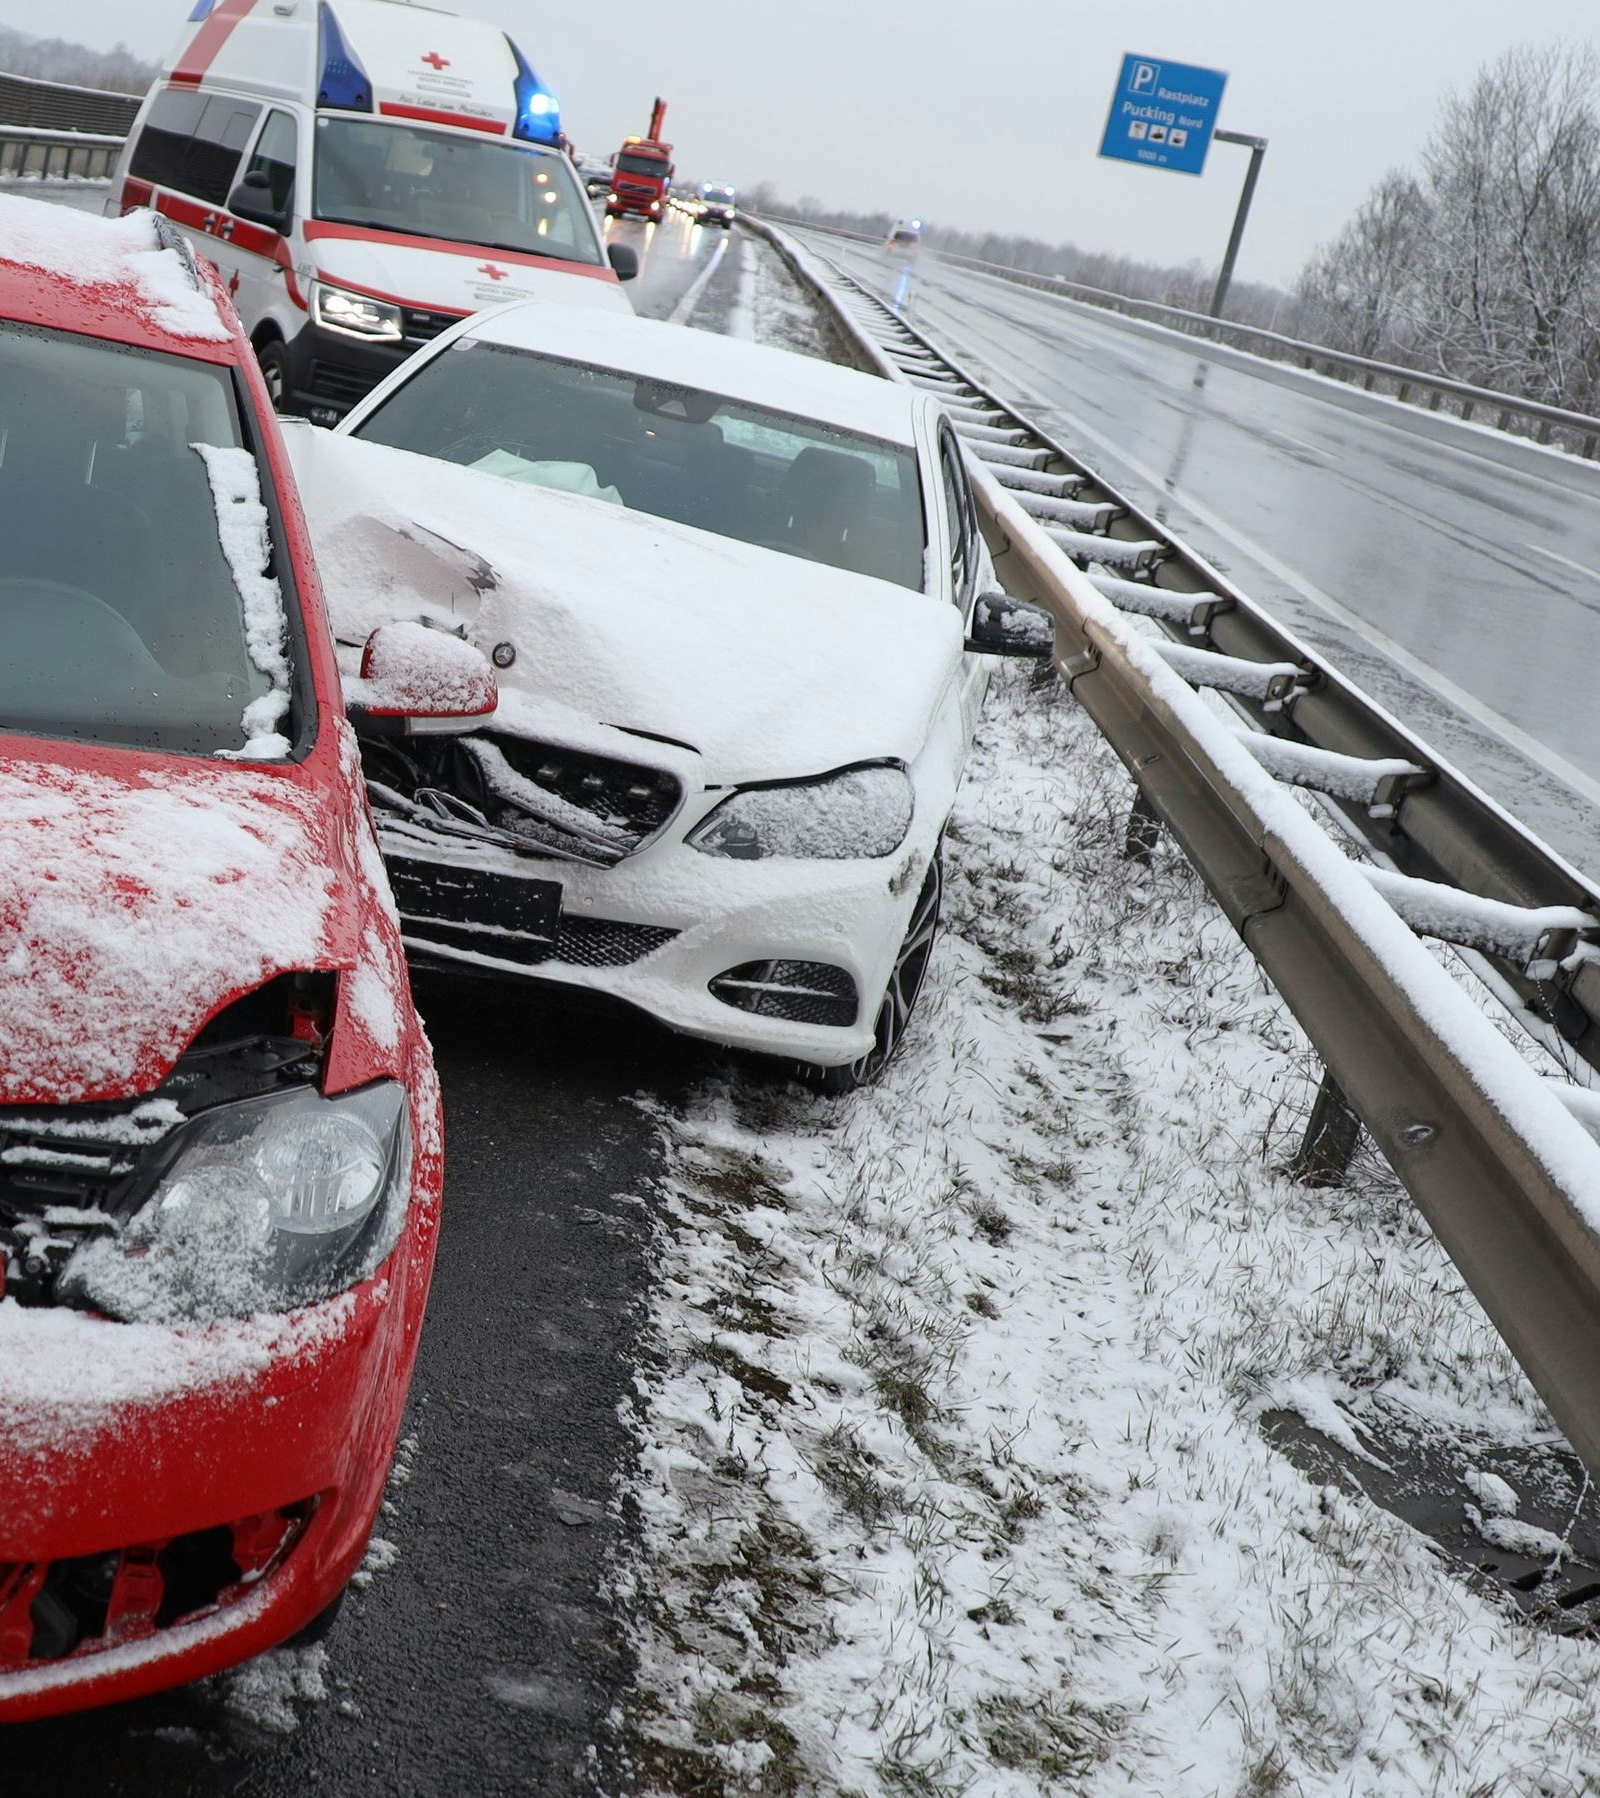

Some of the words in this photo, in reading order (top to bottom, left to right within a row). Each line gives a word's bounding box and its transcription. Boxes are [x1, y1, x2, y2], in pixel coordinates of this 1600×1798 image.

[1133, 64, 1153, 90] P
[1158, 87, 1210, 107] Rastplatz
[1122, 101, 1176, 125] Pucking
[1178, 115, 1204, 129] Nord
